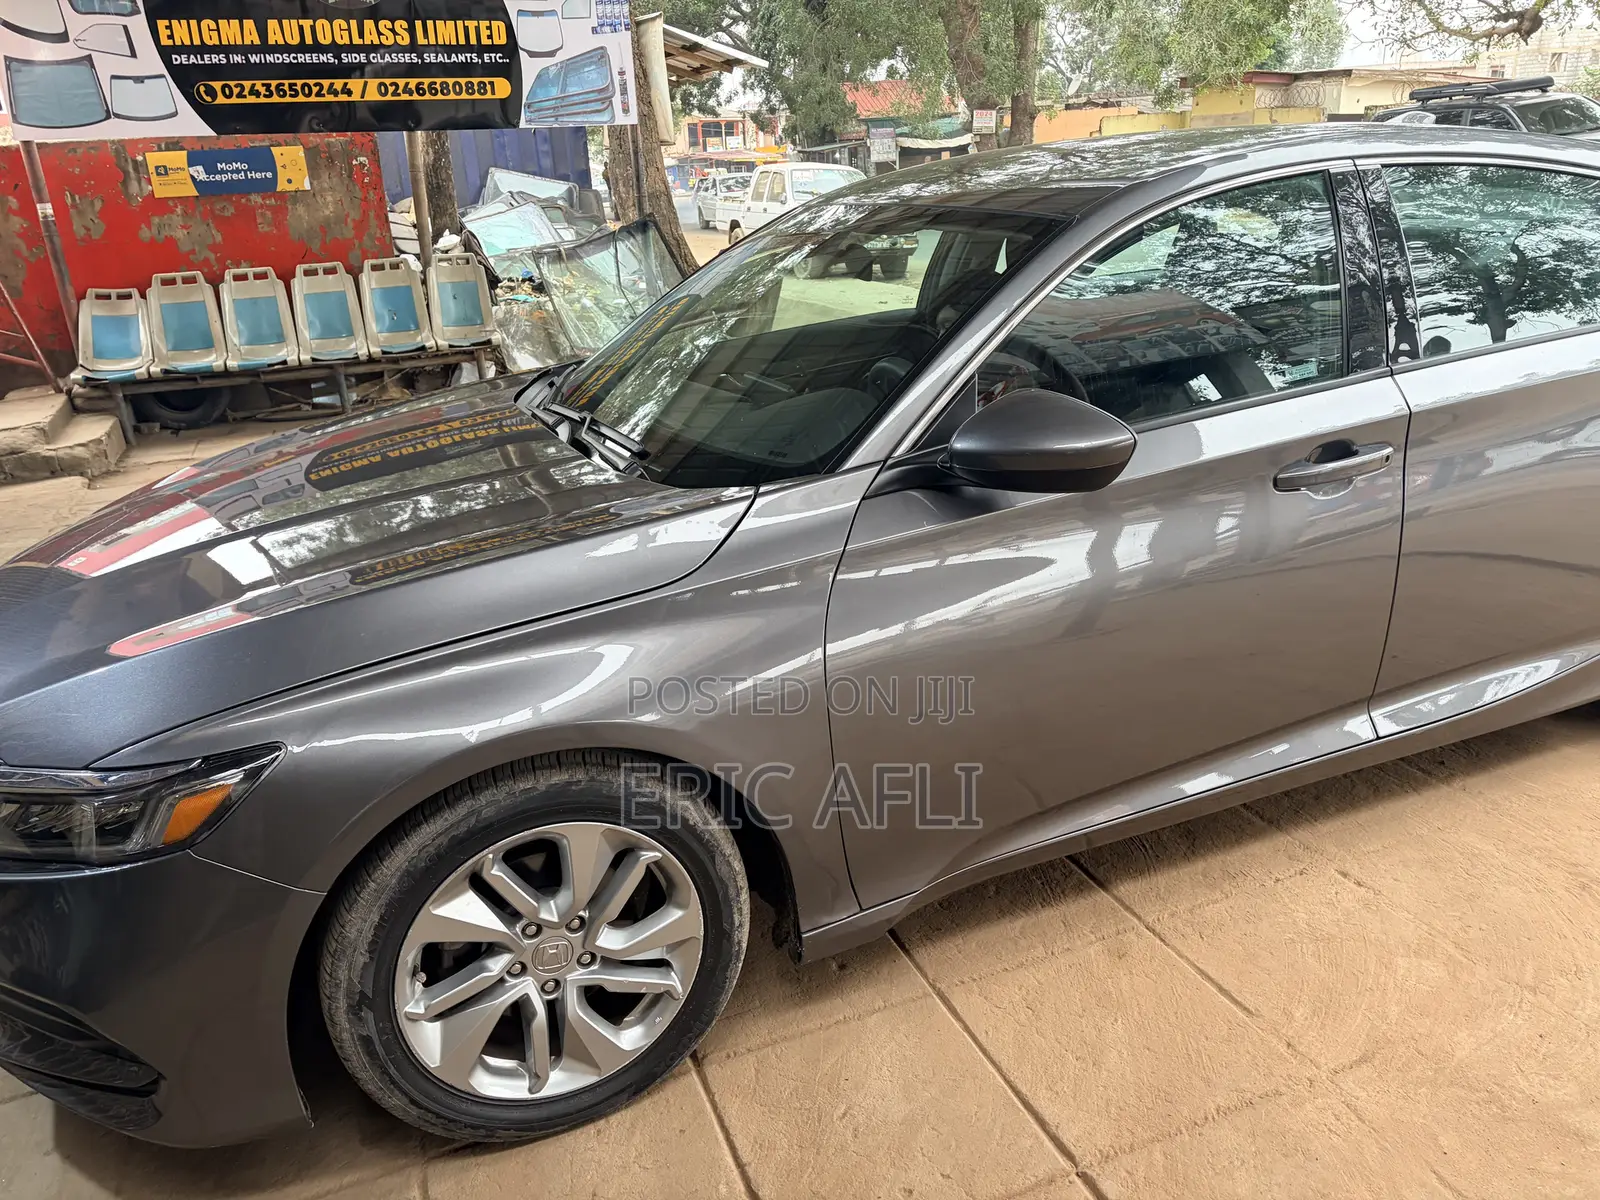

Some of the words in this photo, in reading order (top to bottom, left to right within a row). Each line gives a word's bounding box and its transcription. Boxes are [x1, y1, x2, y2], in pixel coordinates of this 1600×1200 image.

[156, 19, 261, 46] ENIGMA
[267, 19, 410, 46] AUTOGLASS
[414, 19, 508, 46] LIMITED
[172, 53, 227, 65] DEALERS
[230, 53, 246, 64] IN:
[249, 53, 338, 65] WINDSCREENS,
[341, 53, 367, 63] SIDE
[369, 53, 422, 65] GLASSES,
[423, 53, 482, 65] SEALANTS,
[484, 53, 510, 63] ETC..
[220, 80, 354, 99] 0243650244
[360, 80, 369, 99] /
[376, 80, 497, 97] 0246680881
[217, 162, 248, 171] MoMo
[247, 171, 273, 179] Here
